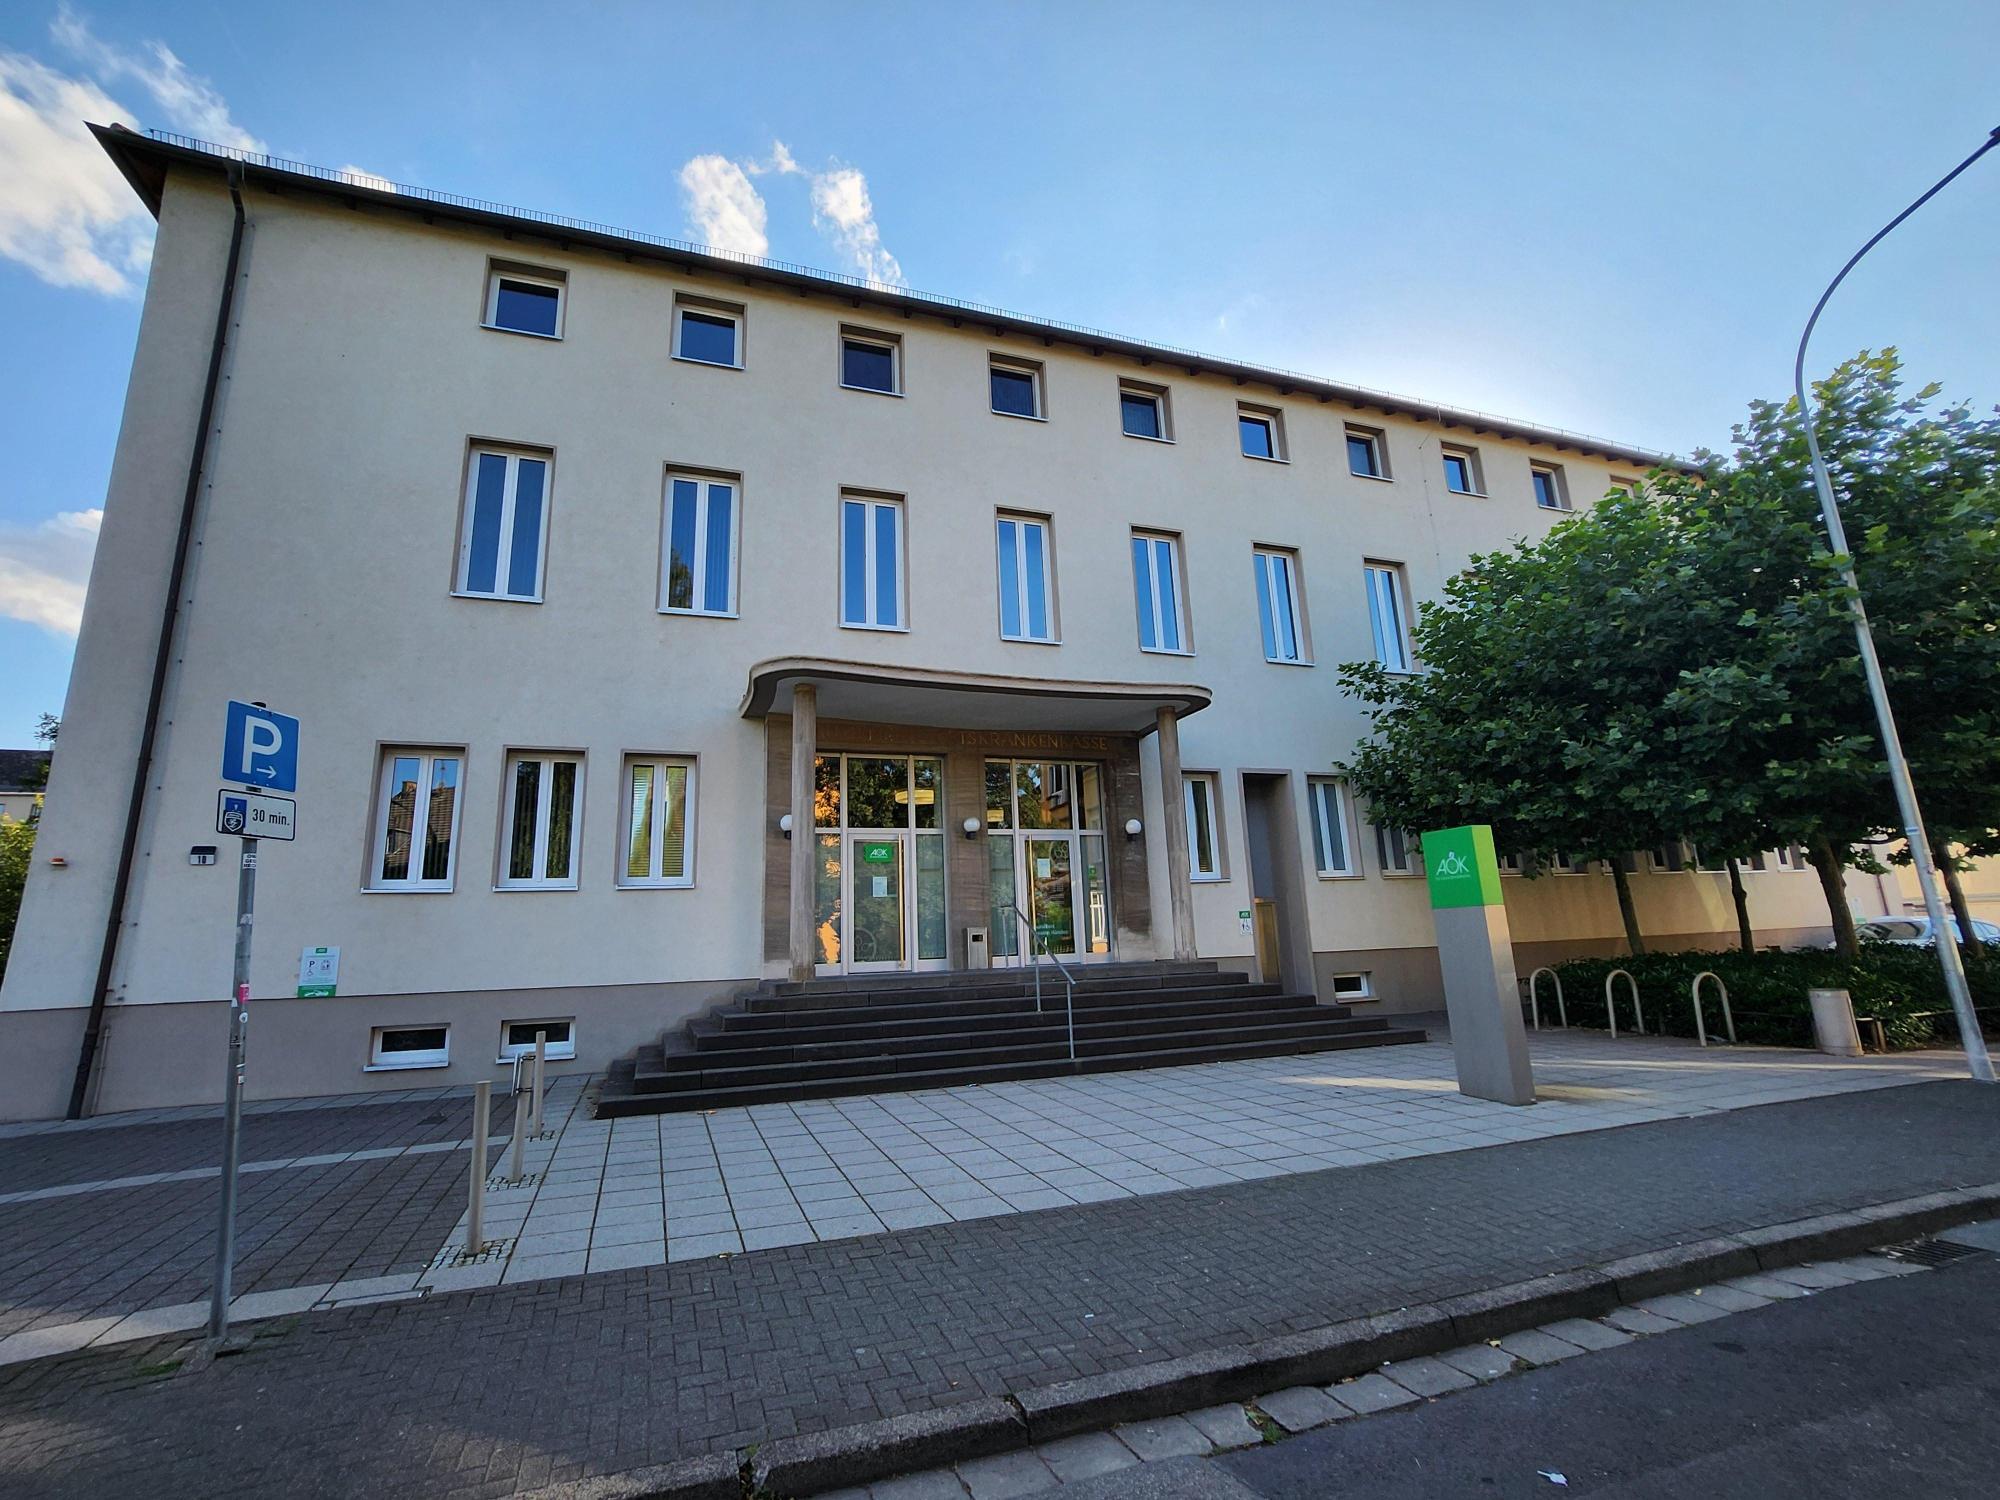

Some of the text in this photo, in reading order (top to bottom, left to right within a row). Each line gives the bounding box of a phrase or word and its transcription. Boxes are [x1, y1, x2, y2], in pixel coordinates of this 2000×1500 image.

[241, 715, 283, 774] P
[252, 808, 265, 823] 30
[268, 811, 290, 826] min.
[870, 848, 888, 857] AOK
[1436, 853, 1469, 875] AOK
[309, 960, 316, 968] P
